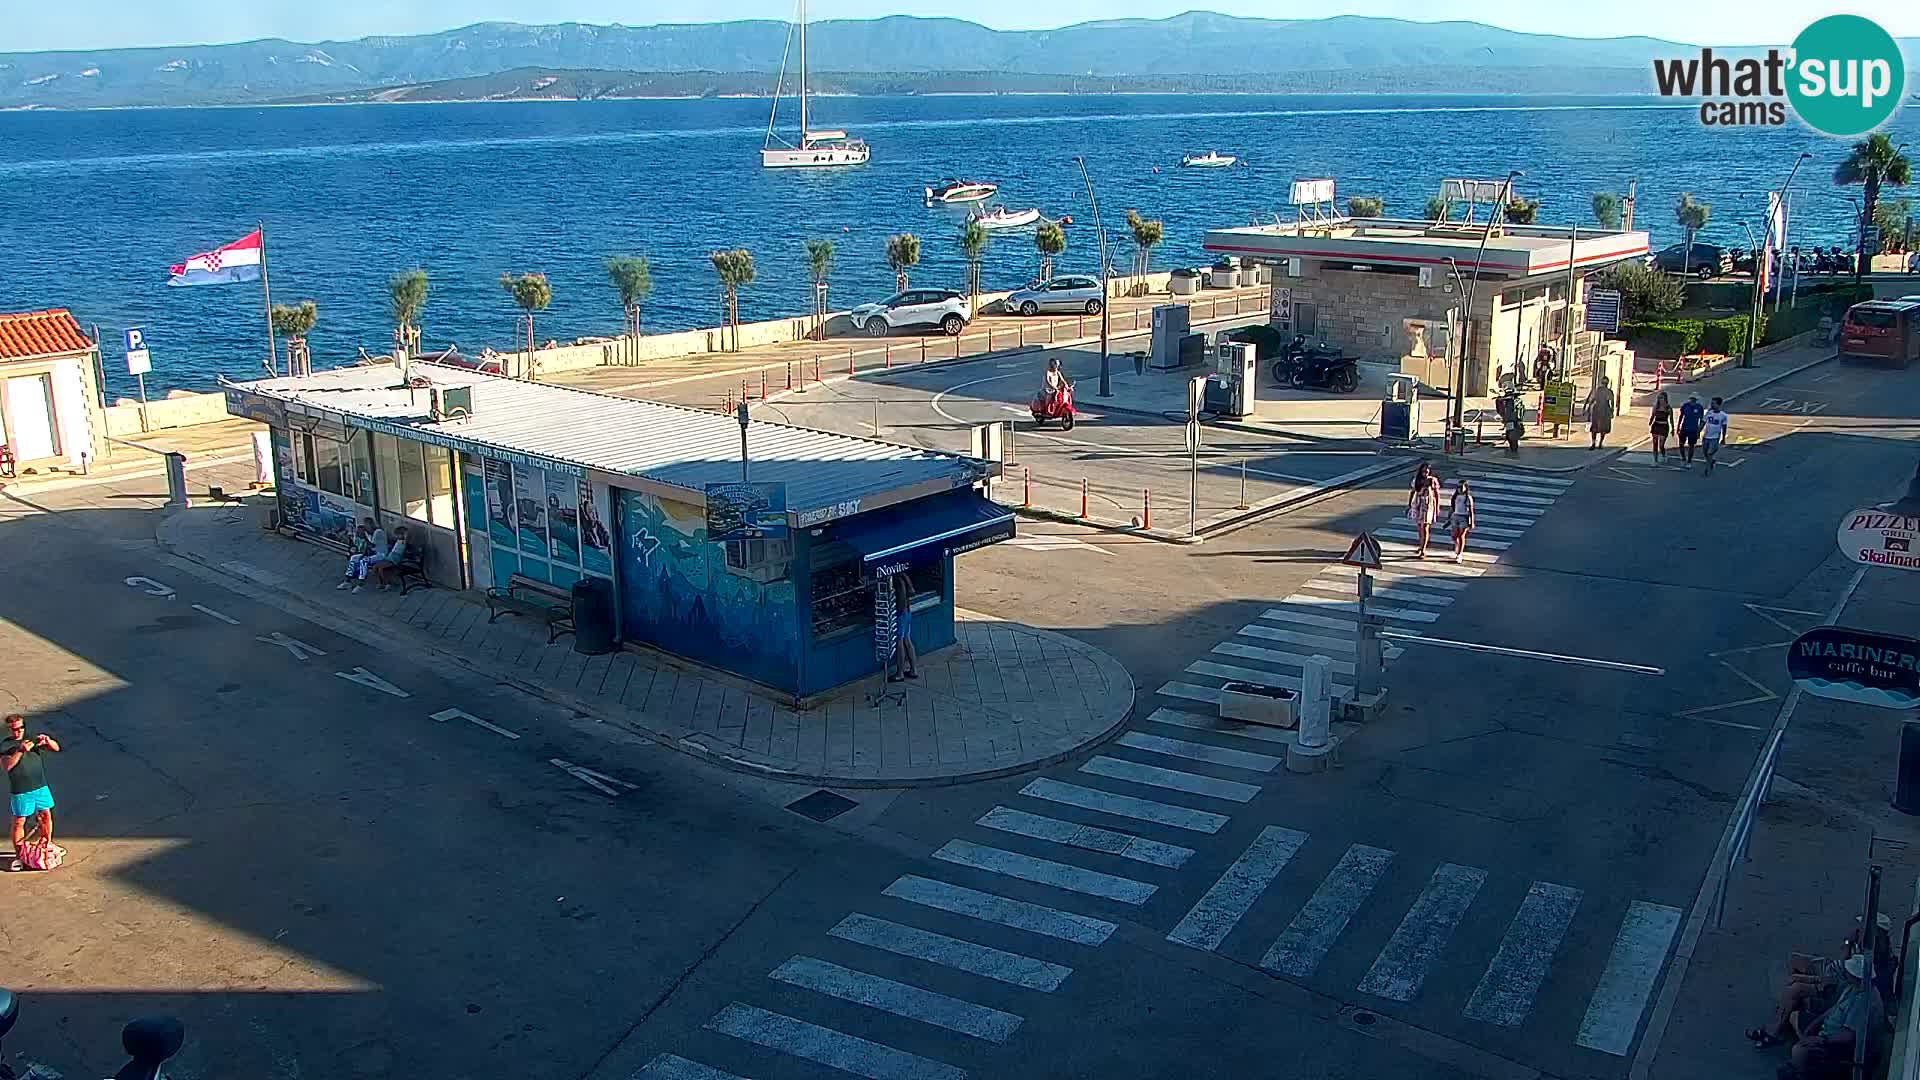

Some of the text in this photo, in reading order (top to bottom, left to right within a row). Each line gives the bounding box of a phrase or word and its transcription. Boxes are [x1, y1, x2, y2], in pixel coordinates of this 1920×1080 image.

[128, 330, 142, 350] P
[1760, 398, 1831, 414] TAXI
[495, 450, 526, 465] STATION
[528, 456, 553, 470] TICKET
[555, 462, 581, 477] OFFICE
[1848, 514, 1920, 532] PIZZE
[1881, 530, 1917, 539] GRILL
[1828, 661, 1896, 679] caffe bar
